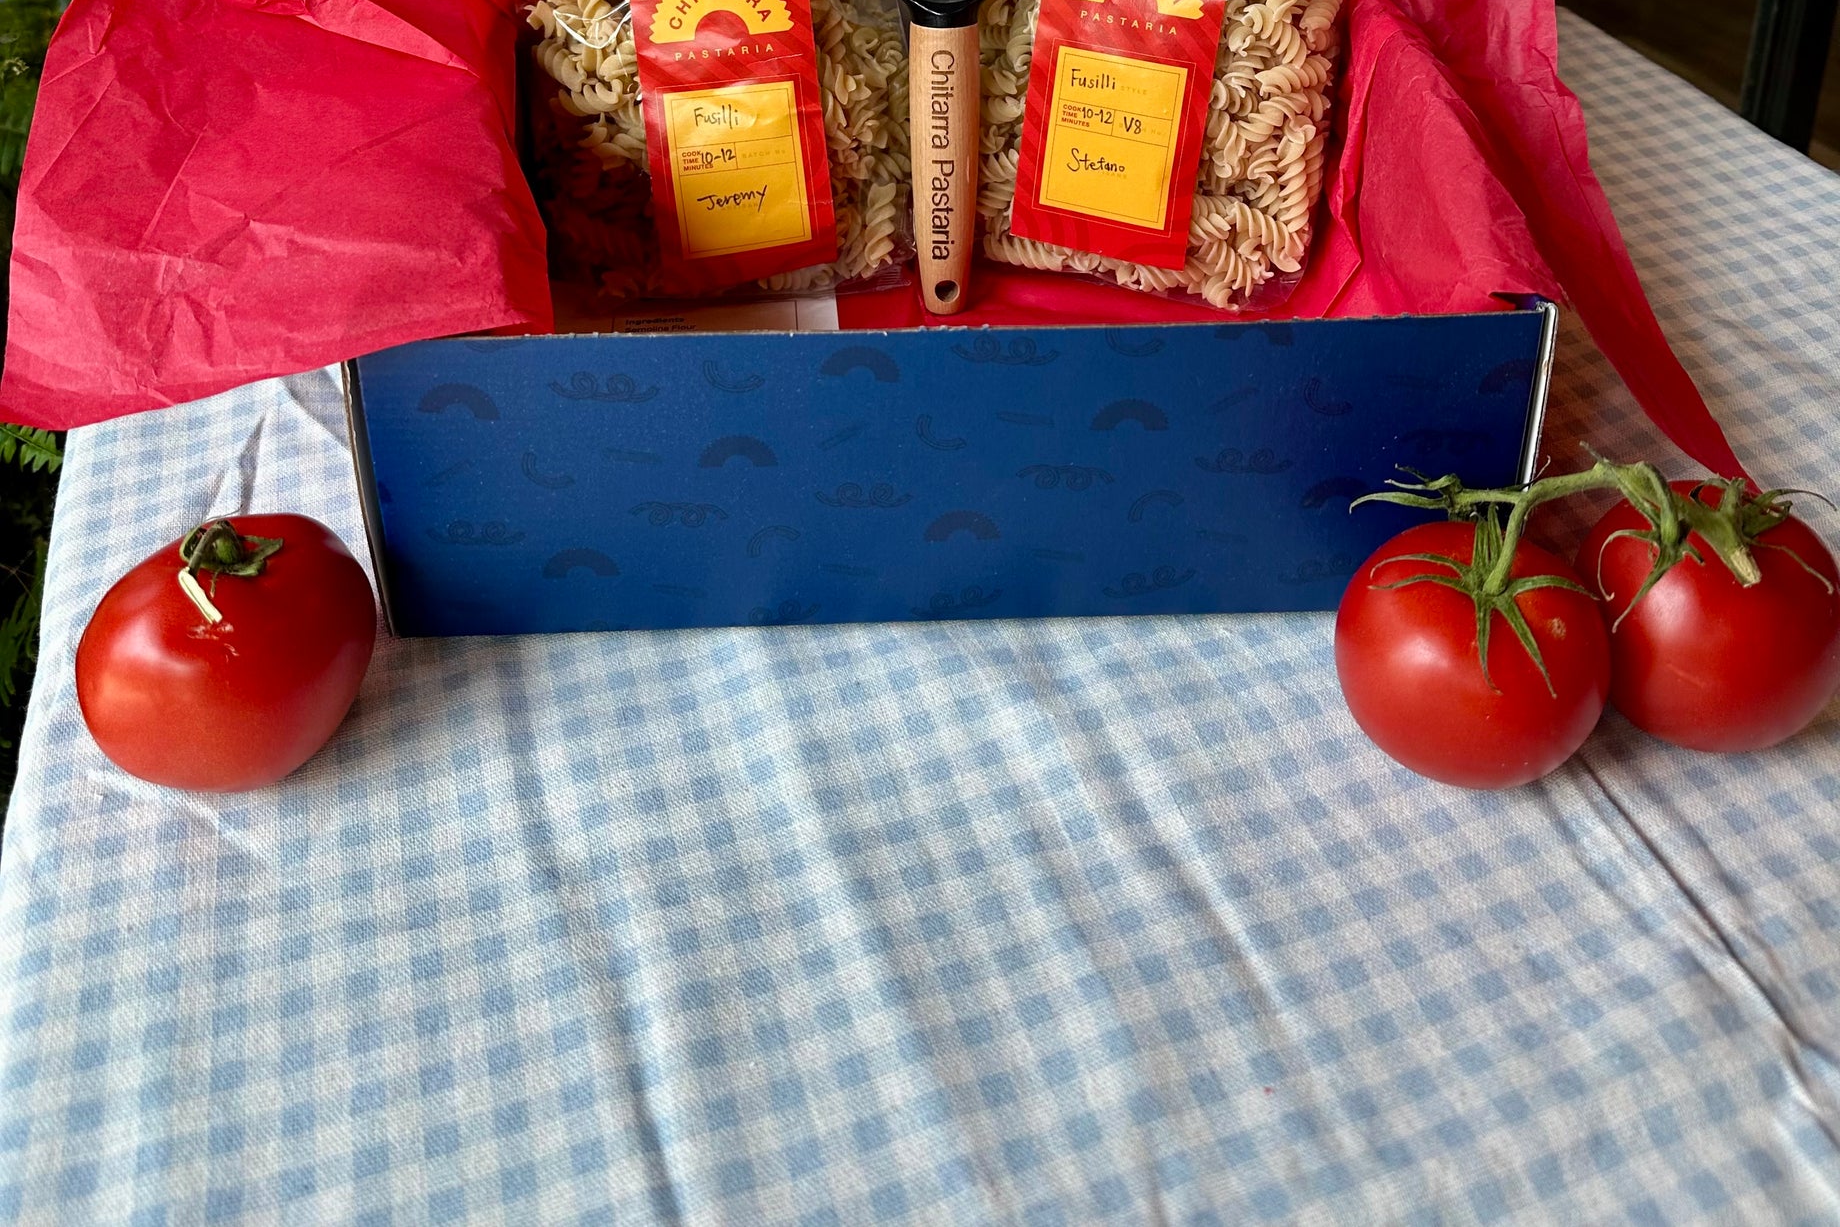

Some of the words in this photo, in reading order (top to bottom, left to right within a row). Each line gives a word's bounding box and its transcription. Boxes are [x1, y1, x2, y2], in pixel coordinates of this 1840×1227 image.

[1080, 10, 1178, 36] PASTARIA
[674, 43, 775, 62] PASTARIA
[1071, 68, 1116, 90] Fusilli
[930, 49, 956, 150] Chitarra
[1062, 104, 1081, 112] COOK
[693, 103, 739, 130] Fusilli
[1060, 117, 1090, 128] MINUTES
[1062, 110, 1078, 119] TIME
[1081, 106, 1114, 125] 10-12
[1123, 116, 1142, 135] V8
[681, 150, 701, 158] COOK
[700, 147, 736, 165] 10-12
[1066, 147, 1126, 173] Stefano
[683, 163, 714, 172] MINUTES
[697, 184, 767, 212] Jeremy
[930, 159, 956, 261] Pastaria
